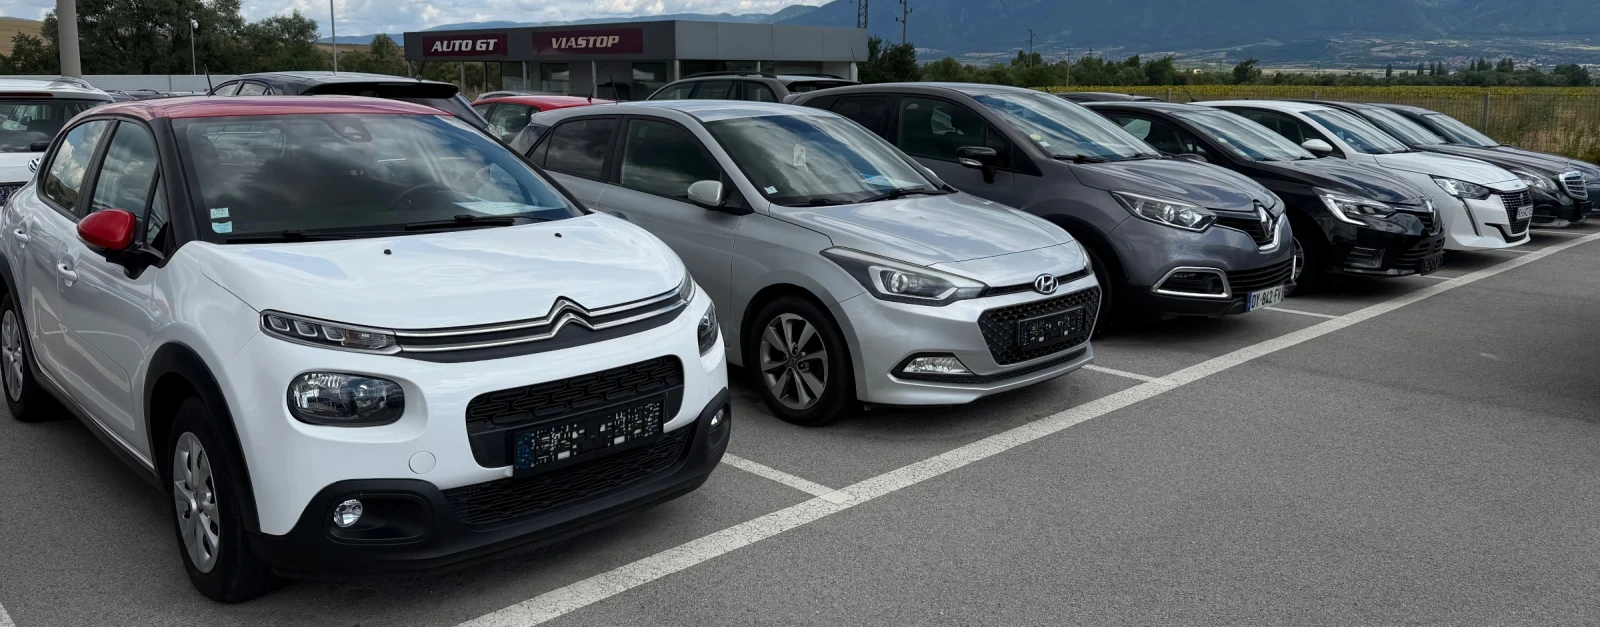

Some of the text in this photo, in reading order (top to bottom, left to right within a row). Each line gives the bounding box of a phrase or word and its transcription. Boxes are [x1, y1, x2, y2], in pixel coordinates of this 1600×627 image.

[431, 38, 498, 52] AUTO GT
[551, 35, 620, 49] VIASTOP
